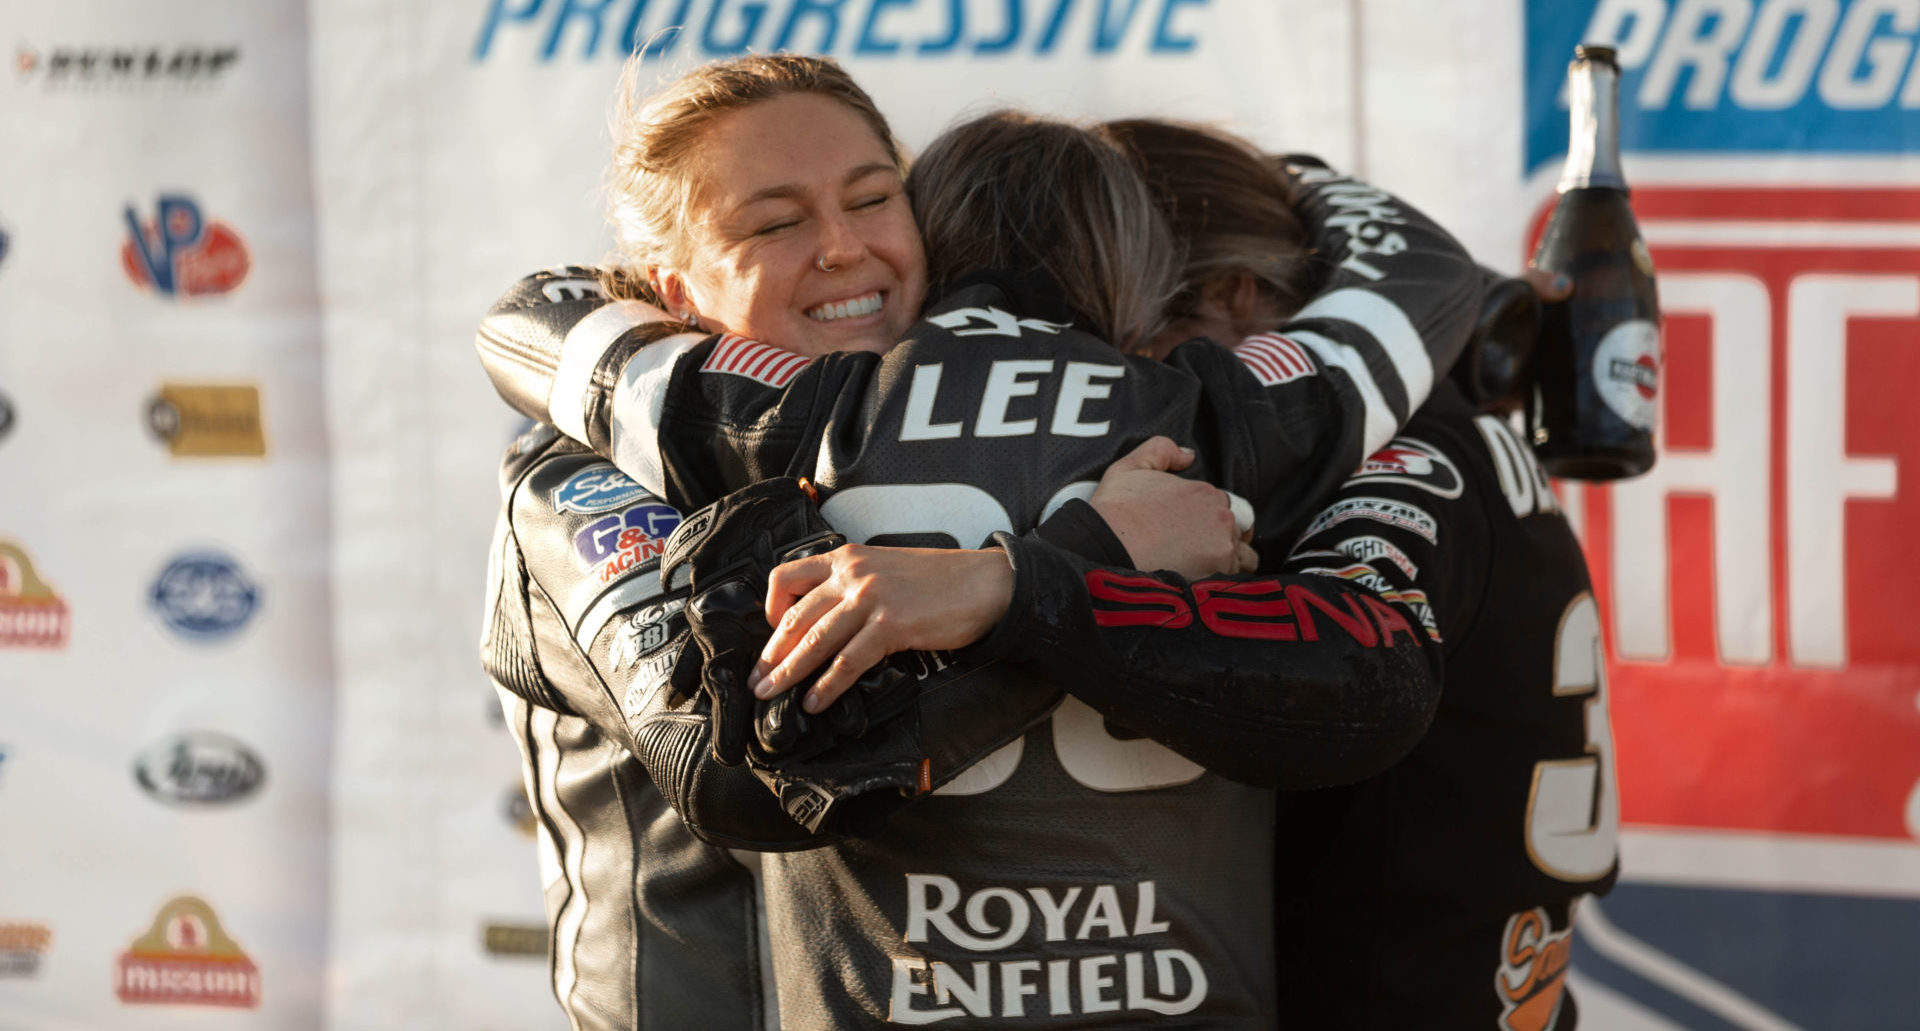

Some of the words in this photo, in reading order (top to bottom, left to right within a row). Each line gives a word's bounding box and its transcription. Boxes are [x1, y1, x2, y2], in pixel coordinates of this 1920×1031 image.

[1555, 0, 1920, 109] PROG
[899, 359, 1125, 442] LEE
[1085, 567, 1422, 649] SENA
[904, 872, 1171, 951] ROYAL
[887, 948, 1209, 1026] ENFIELD
